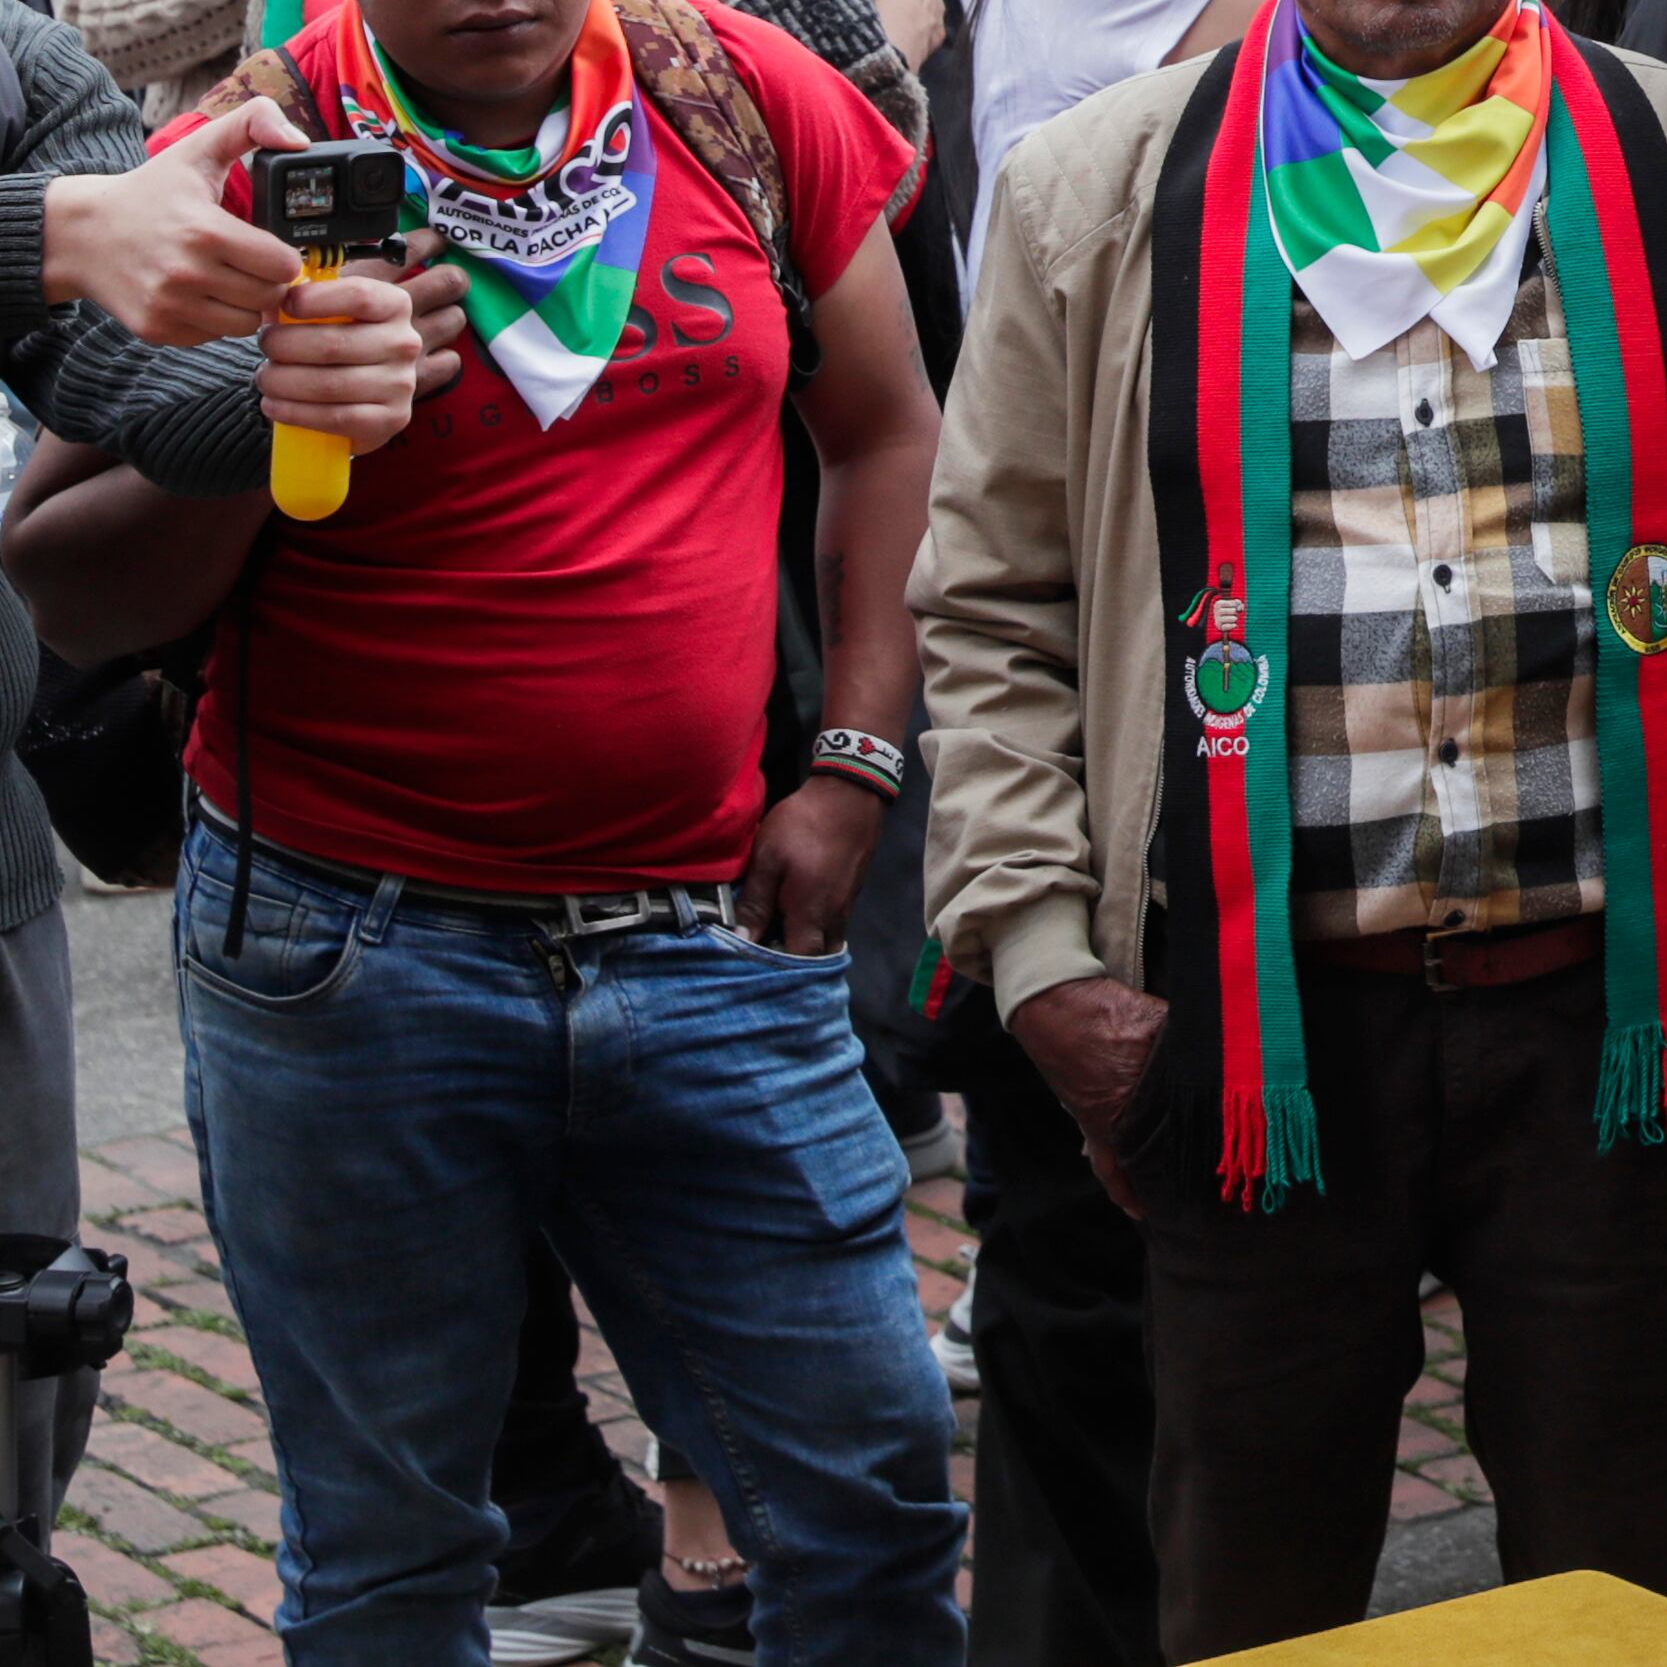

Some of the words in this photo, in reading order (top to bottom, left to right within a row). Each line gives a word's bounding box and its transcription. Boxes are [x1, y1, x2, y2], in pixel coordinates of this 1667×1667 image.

[435, 205, 530, 239] AUTORIDADES
[489, 234, 520, 255] LA
[526, 208, 611, 257] PACHA
[594, 354, 741, 404] BOSS
[1196, 735, 1250, 758] AICO
